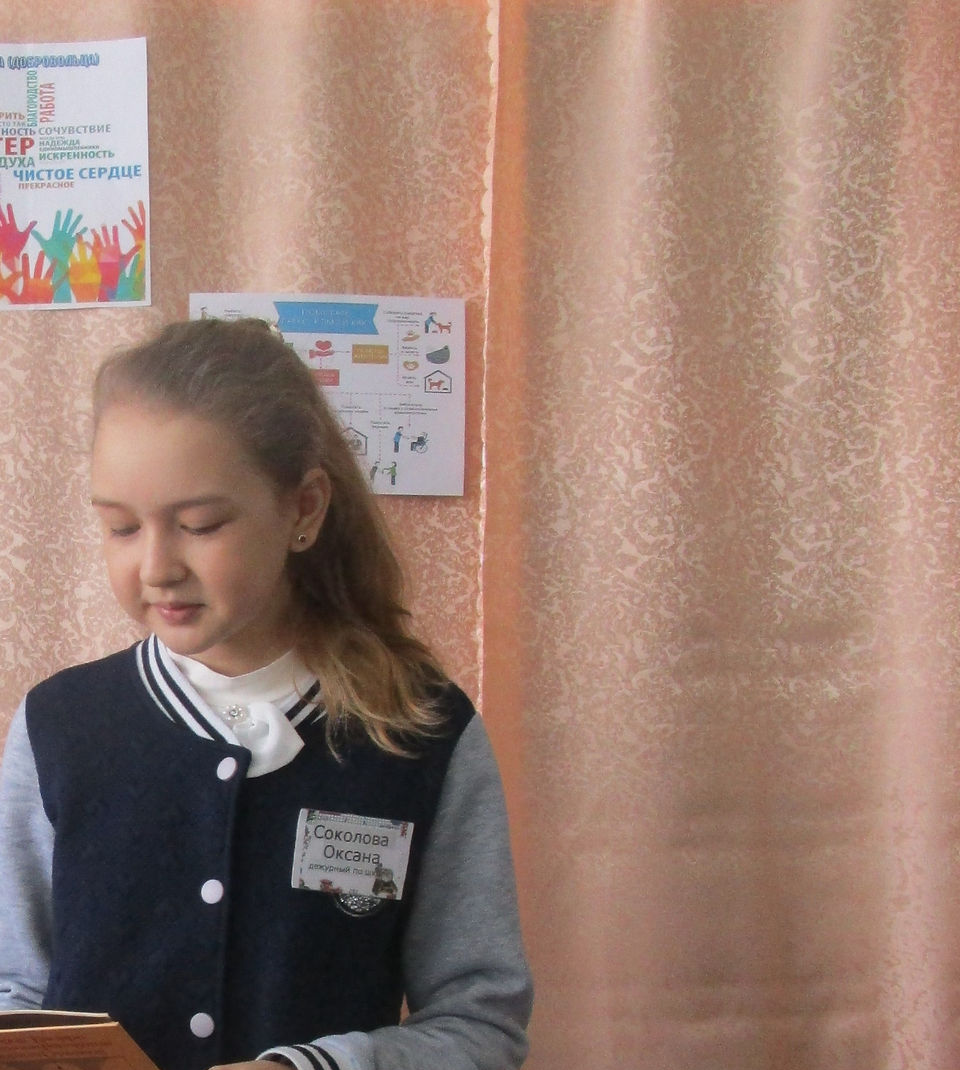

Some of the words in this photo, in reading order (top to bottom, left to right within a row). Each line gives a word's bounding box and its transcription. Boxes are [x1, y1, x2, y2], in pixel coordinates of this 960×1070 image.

[26, 70, 38, 127] БЛАГОРОДСТВО
[39, 82, 55, 123] РАБОТА
[38, 124, 112, 136] СОЧУВСТВИЕ
[39, 139, 81, 147] НАДЕЖДА
[39, 150, 115, 161] ИСКРЕННОСТЬ
[13, 168, 74, 182] ЧИСТОЕ
[78, 164, 143, 181] СЕРДЦЕ
[18, 181, 75, 190] ПРЕКРАСНОЕ
[313, 824, 389, 847] Соколова
[323, 845, 380, 865] Оксана
